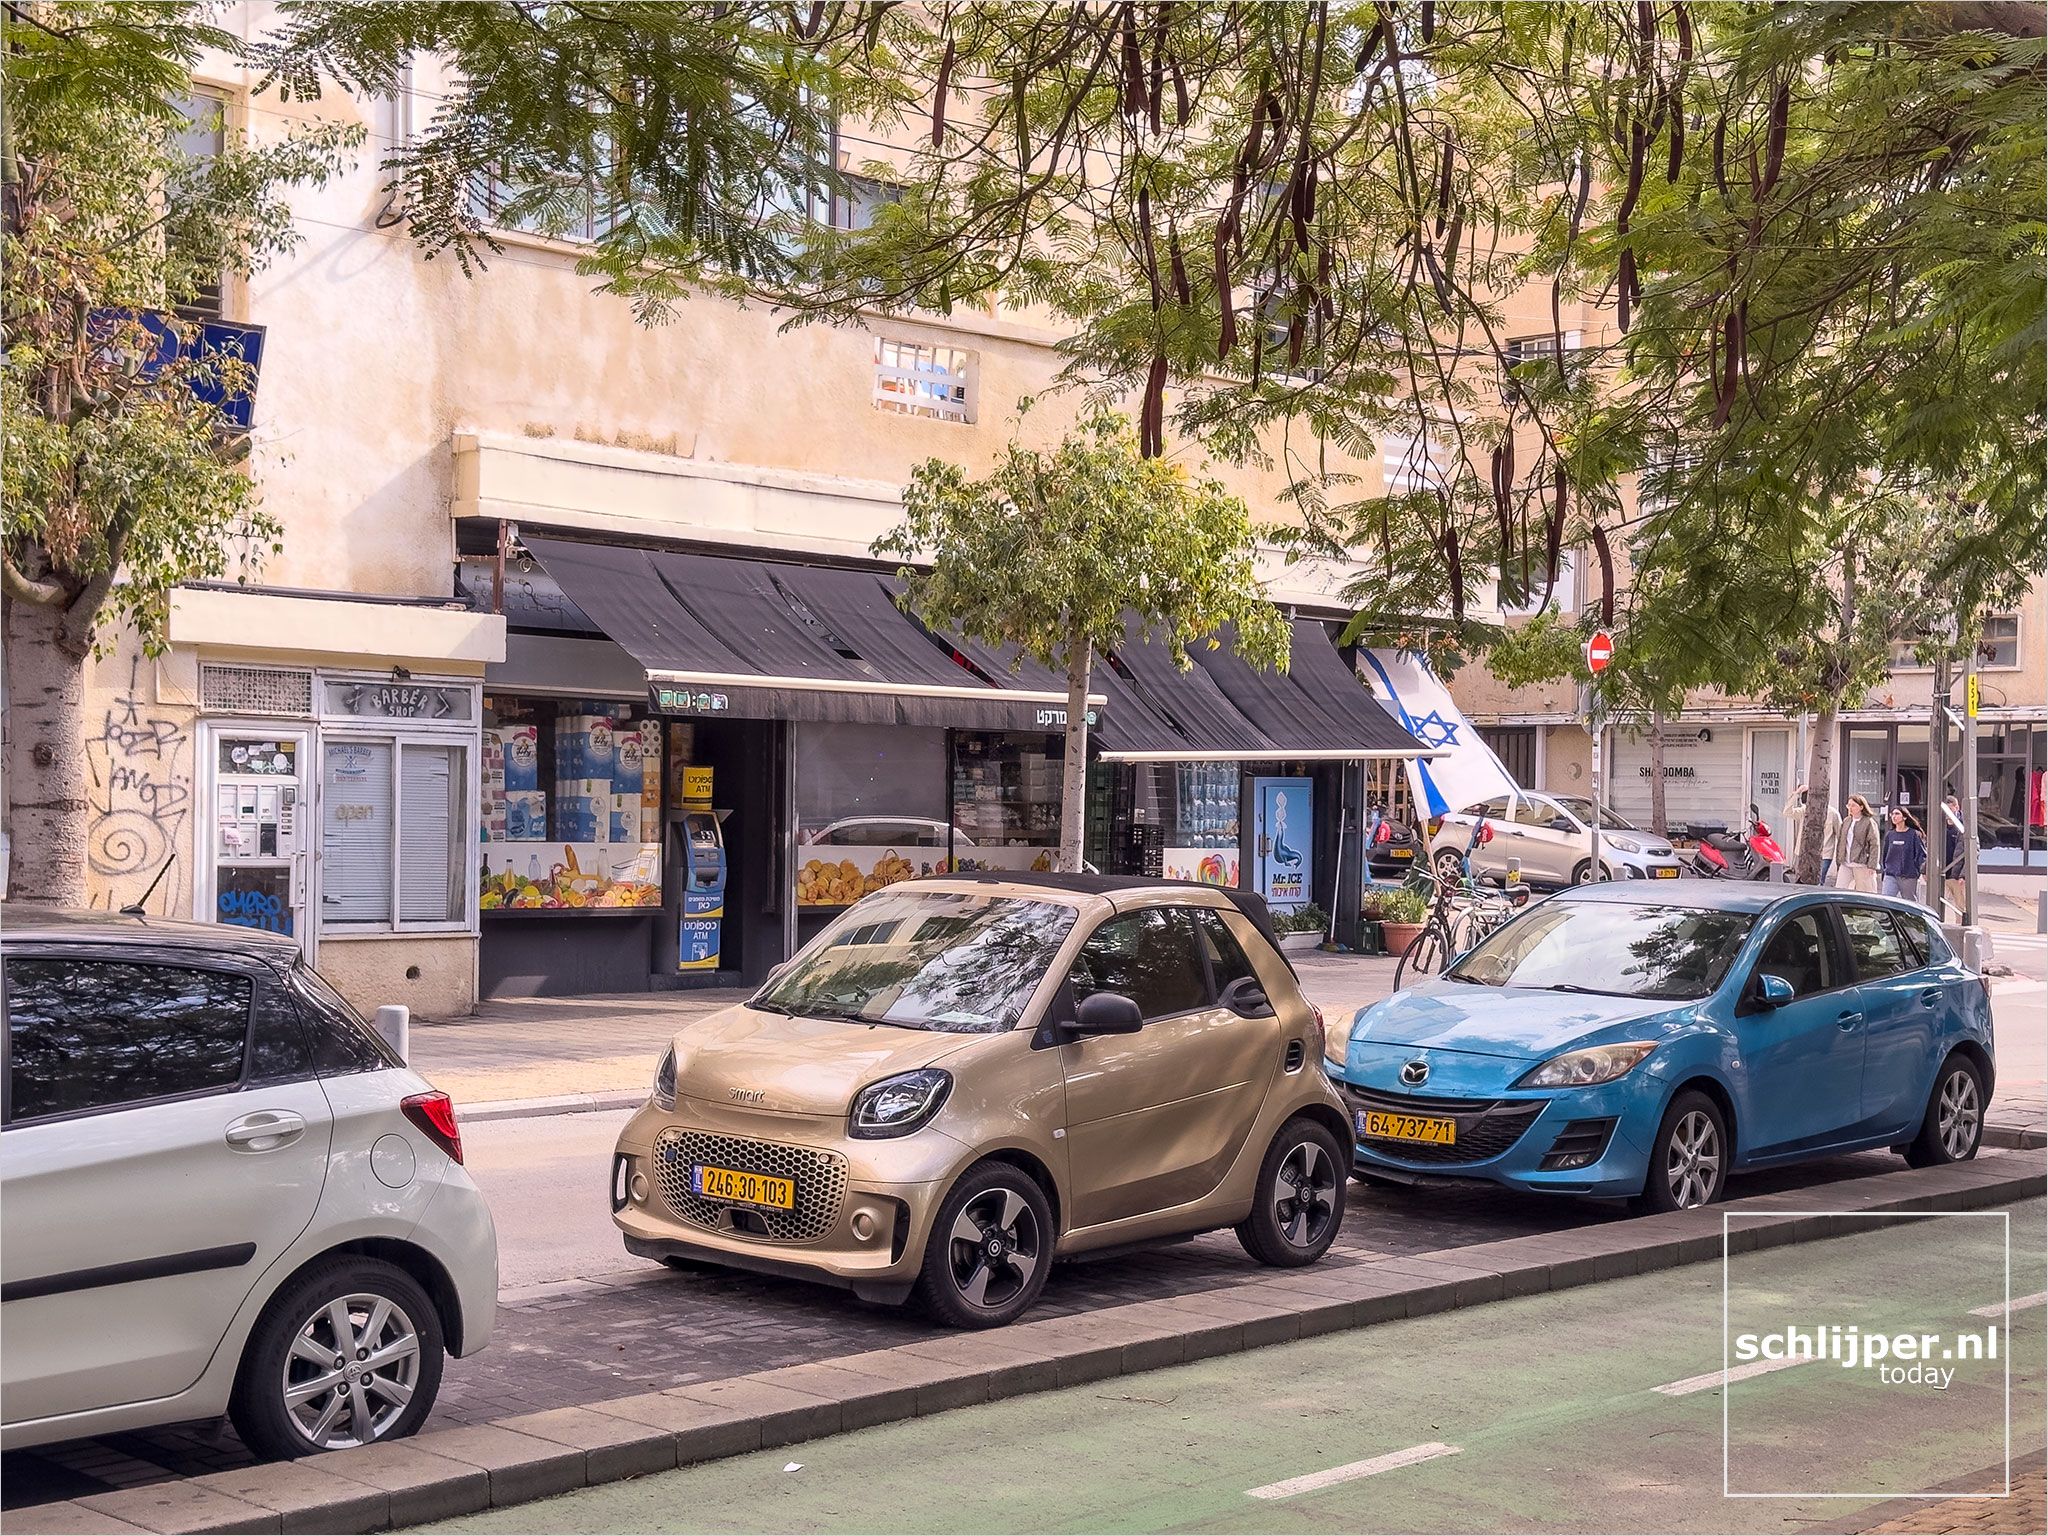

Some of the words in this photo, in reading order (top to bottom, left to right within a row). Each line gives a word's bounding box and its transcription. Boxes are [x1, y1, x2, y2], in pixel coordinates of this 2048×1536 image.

[371, 688, 428, 710] BARBER
[388, 705, 415, 717] SHOP
[1639, 766, 1695, 778] SHOOMBA
[695, 784, 711, 793] ATM
[335, 804, 373, 827] open
[1272, 873, 1286, 884] Mr.
[1287, 872, 1303, 884] ICE
[684, 920, 717, 931] כספומט
[692, 931, 709, 940] ATM
[728, 1086, 766, 1104] smart
